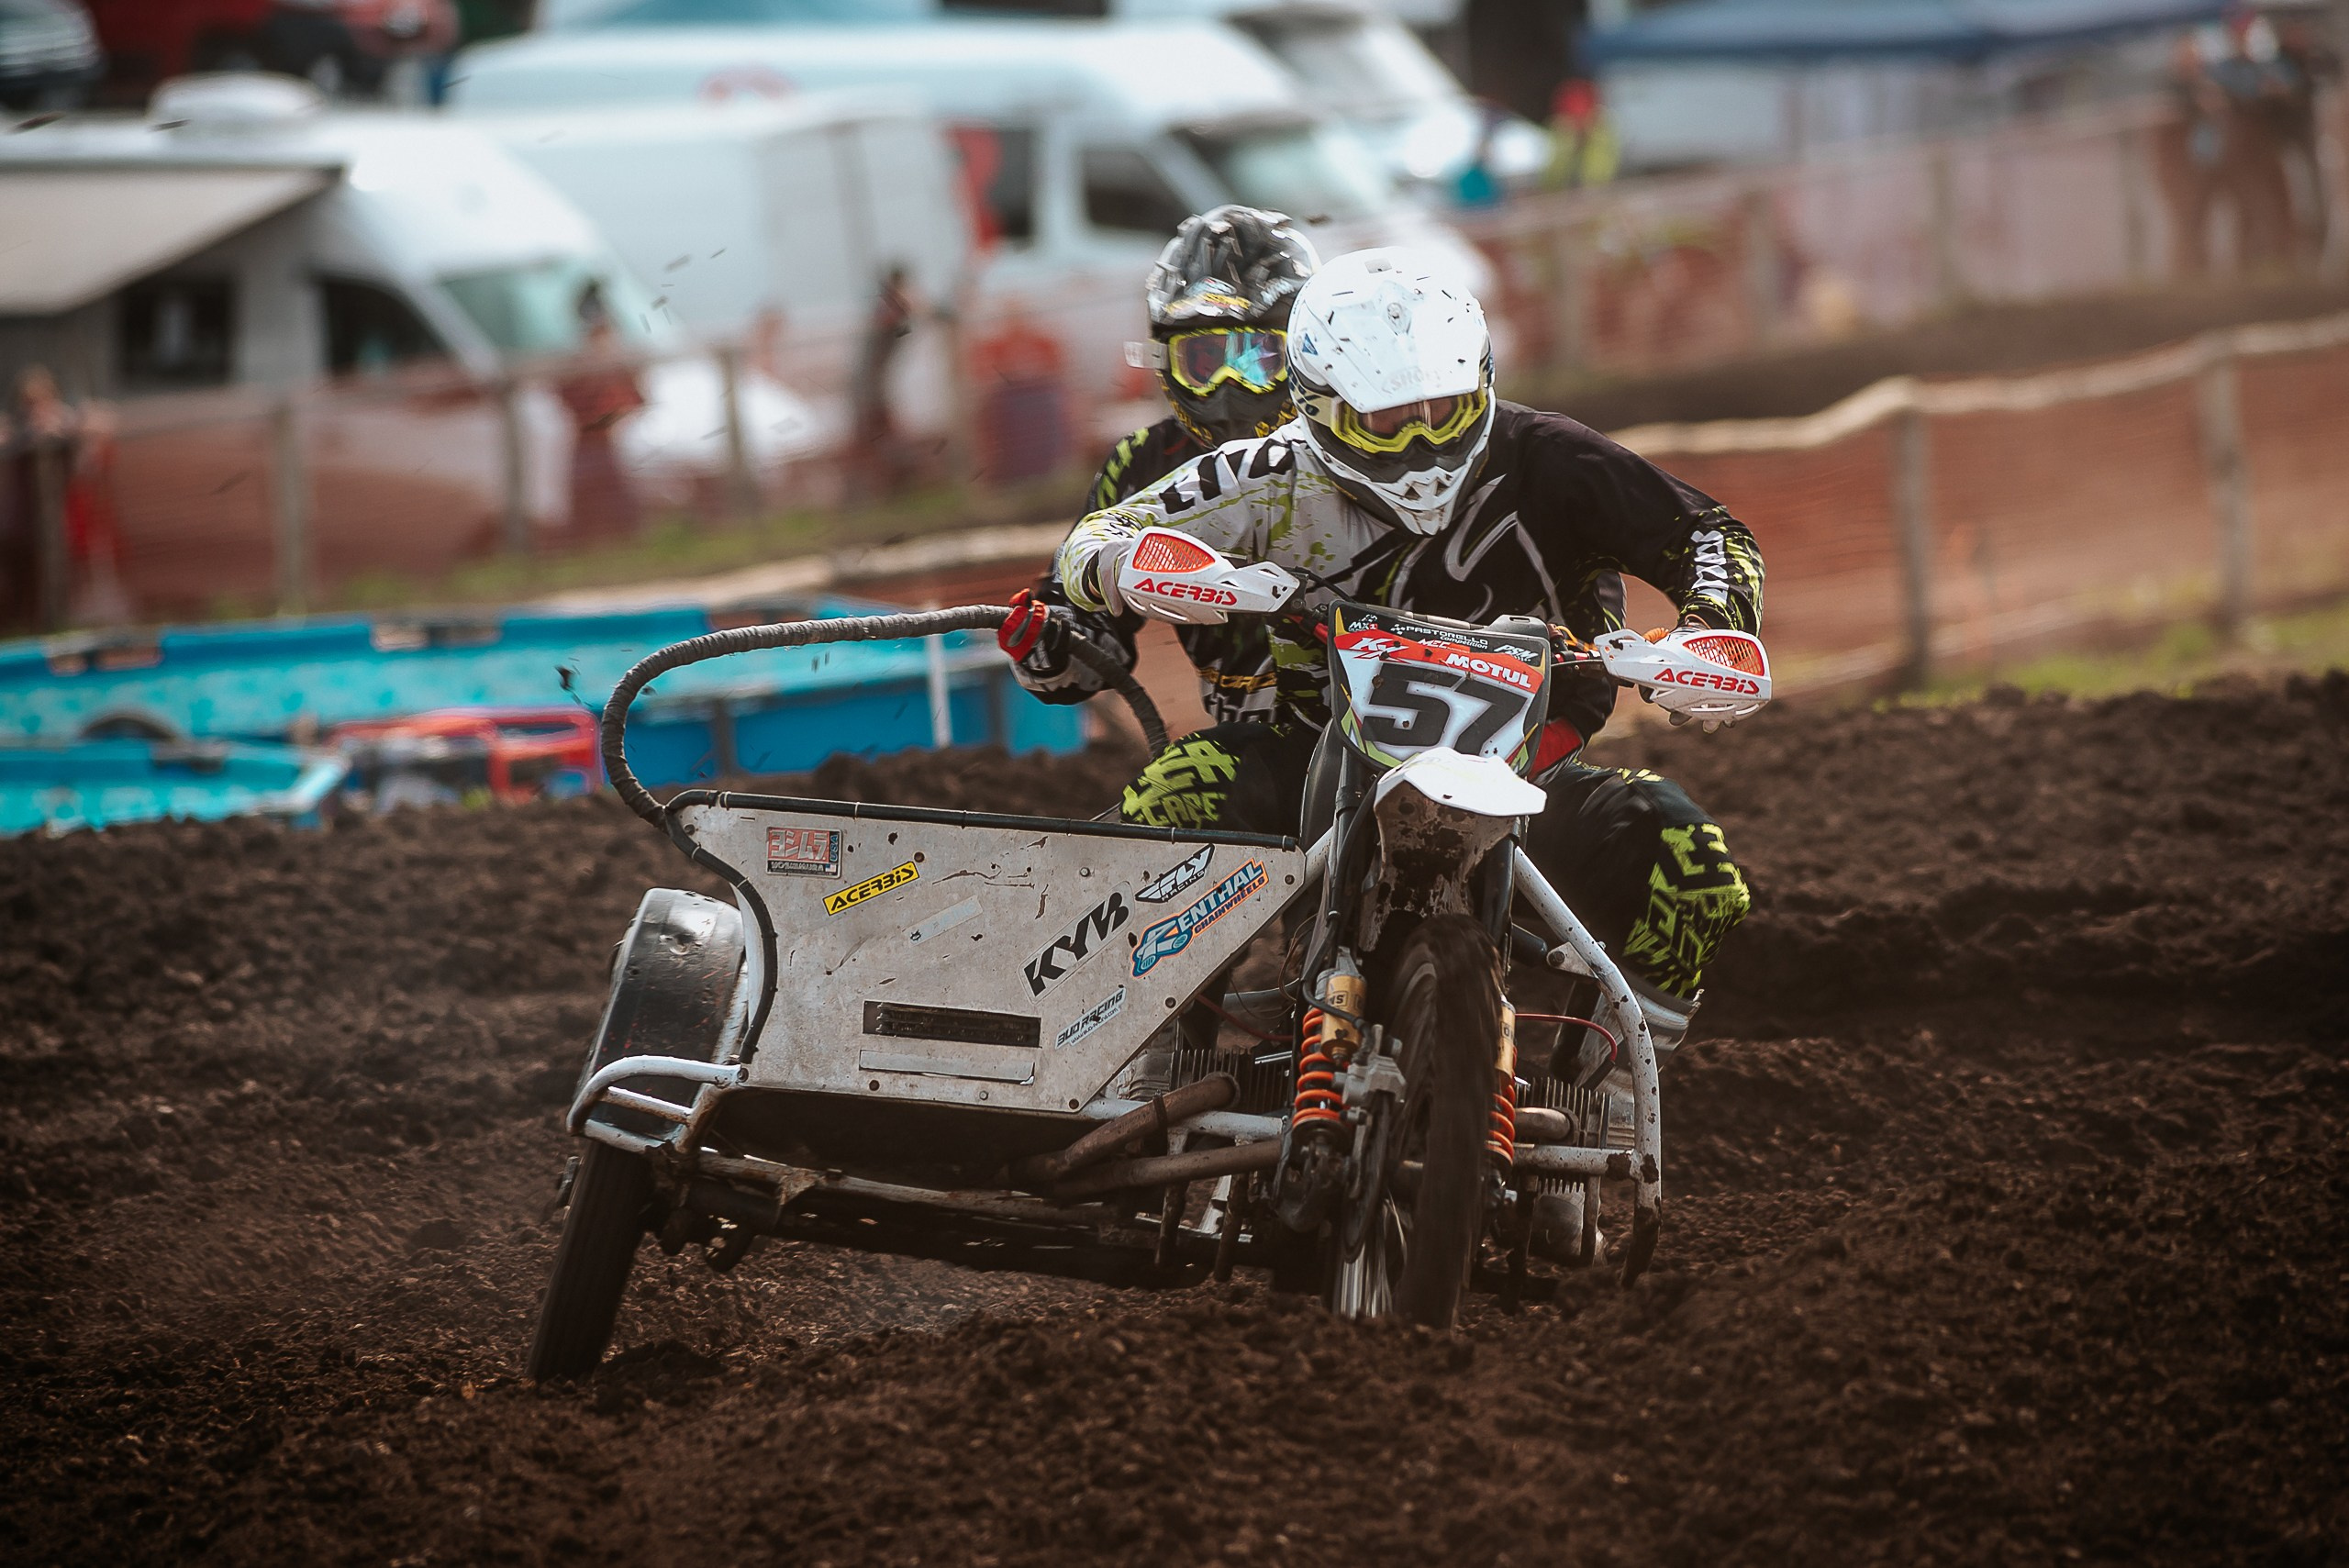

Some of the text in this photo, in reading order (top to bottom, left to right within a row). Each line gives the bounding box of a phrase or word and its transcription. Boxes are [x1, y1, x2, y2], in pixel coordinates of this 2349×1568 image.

[1134, 578, 1238, 606] ACERBIS
[1406, 626, 1488, 645] PASTORELLO
[1494, 644, 1538, 659] PSM
[1445, 652, 1532, 688] MOTUL
[1654, 668, 1760, 695] ACERBIS
[1360, 662, 1529, 757] 57
[771, 829, 828, 861] ヨシムラ
[829, 834, 839, 862] USA
[1138, 846, 1212, 899] FLY
[1162, 870, 1205, 901] RACING
[830, 867, 915, 911] ACERBIS
[1194, 875, 1266, 934] CHAINWHEELS
[1024, 892, 1130, 997] KYB
